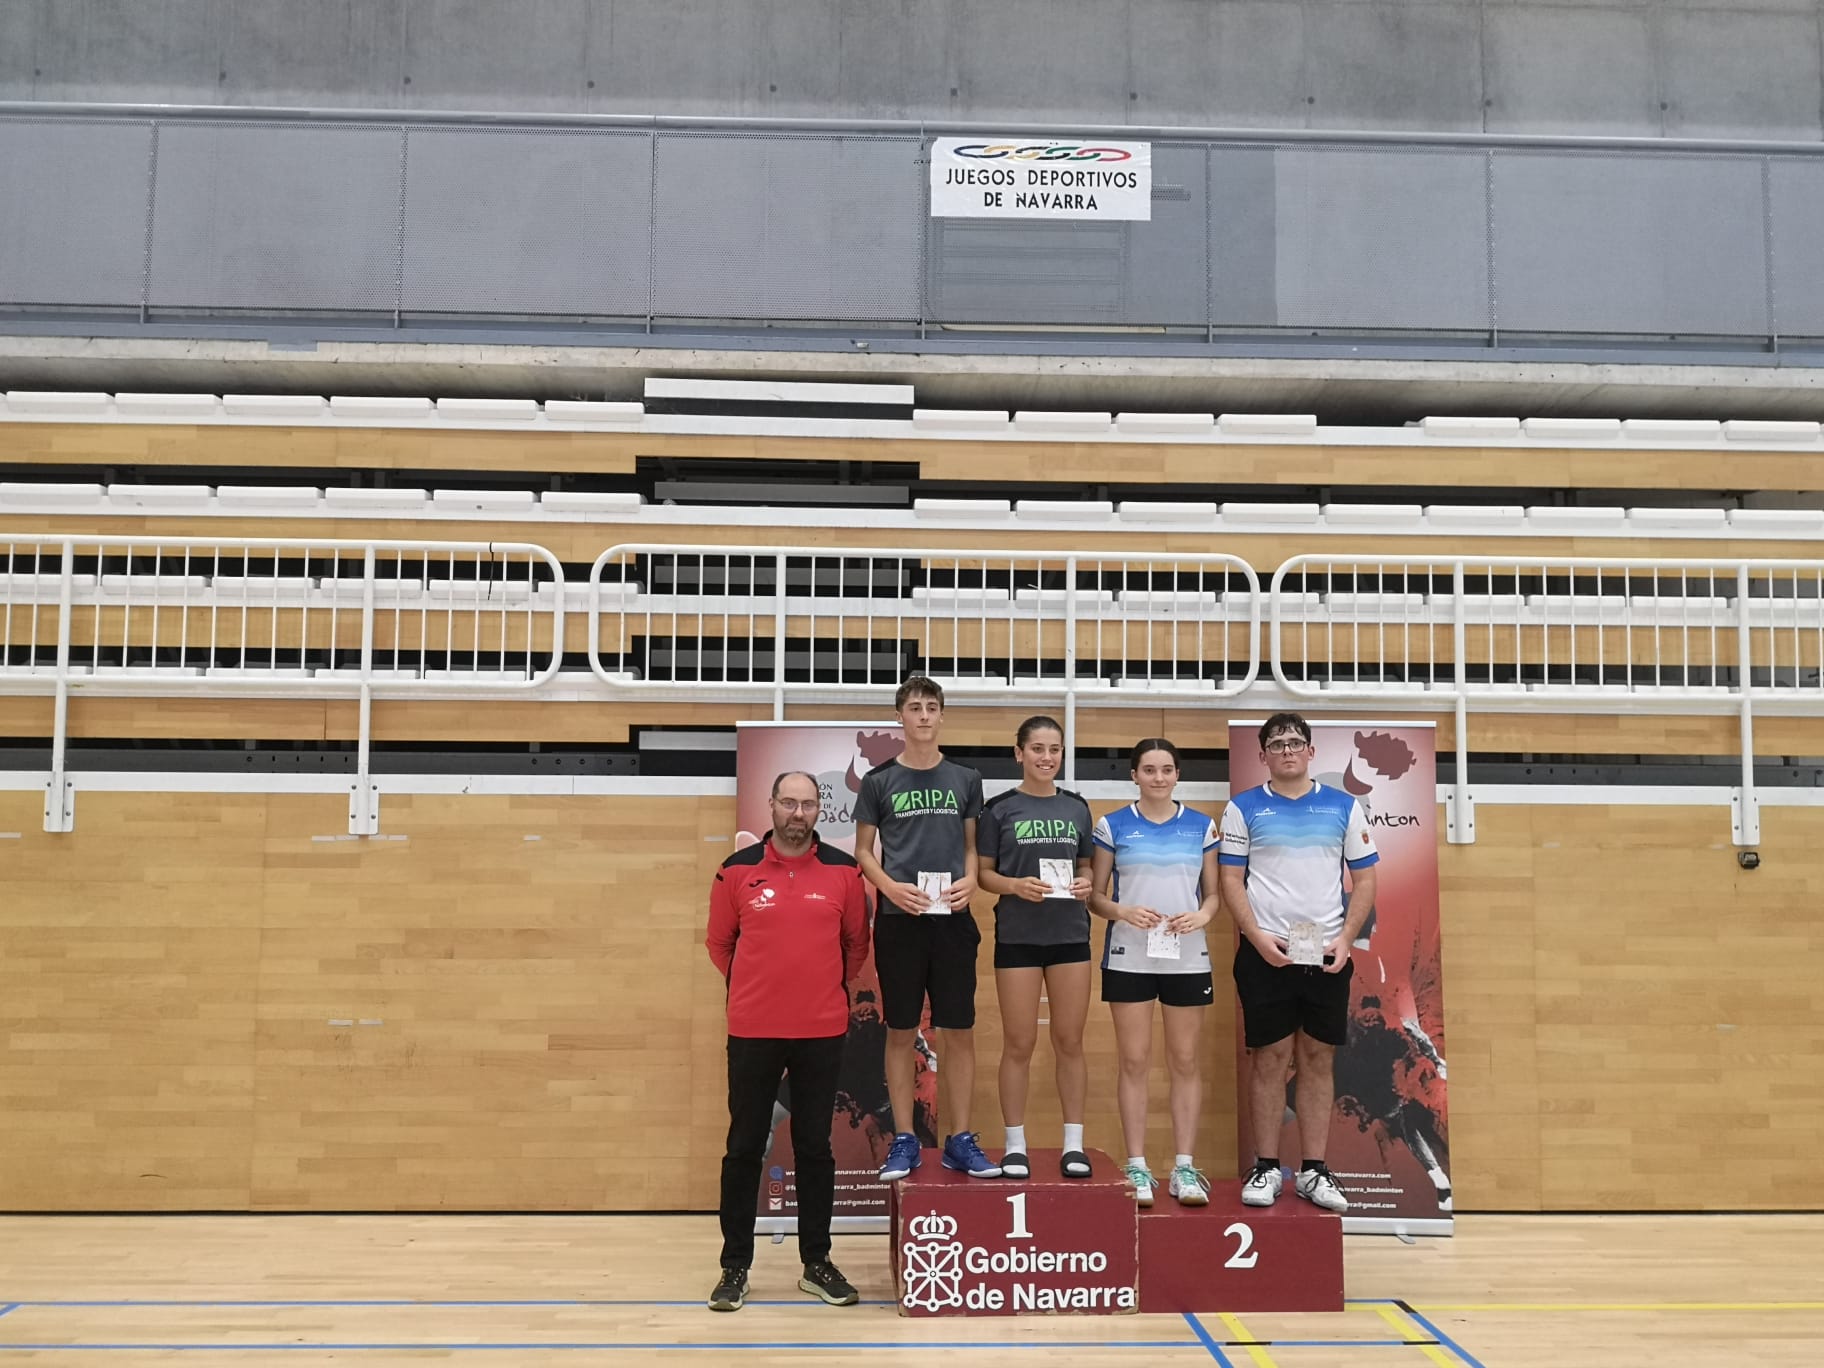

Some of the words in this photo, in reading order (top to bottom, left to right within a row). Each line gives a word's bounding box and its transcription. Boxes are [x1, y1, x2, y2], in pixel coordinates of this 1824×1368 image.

[946, 168, 1015, 186] JUEGOS
[1028, 169, 1137, 188] DEPORTIVOS
[984, 191, 1003, 207] DE
[1015, 192, 1098, 210] NAVARRA
[911, 789, 958, 809] RIPA
[1033, 819, 1077, 839] RIPA
[1005, 1192, 1034, 1239] 1
[1223, 1222, 1259, 1268] 2
[965, 1246, 1107, 1275] Gobierno
[965, 1282, 1005, 1310] de
[1013, 1283, 1136, 1311] Navarra
